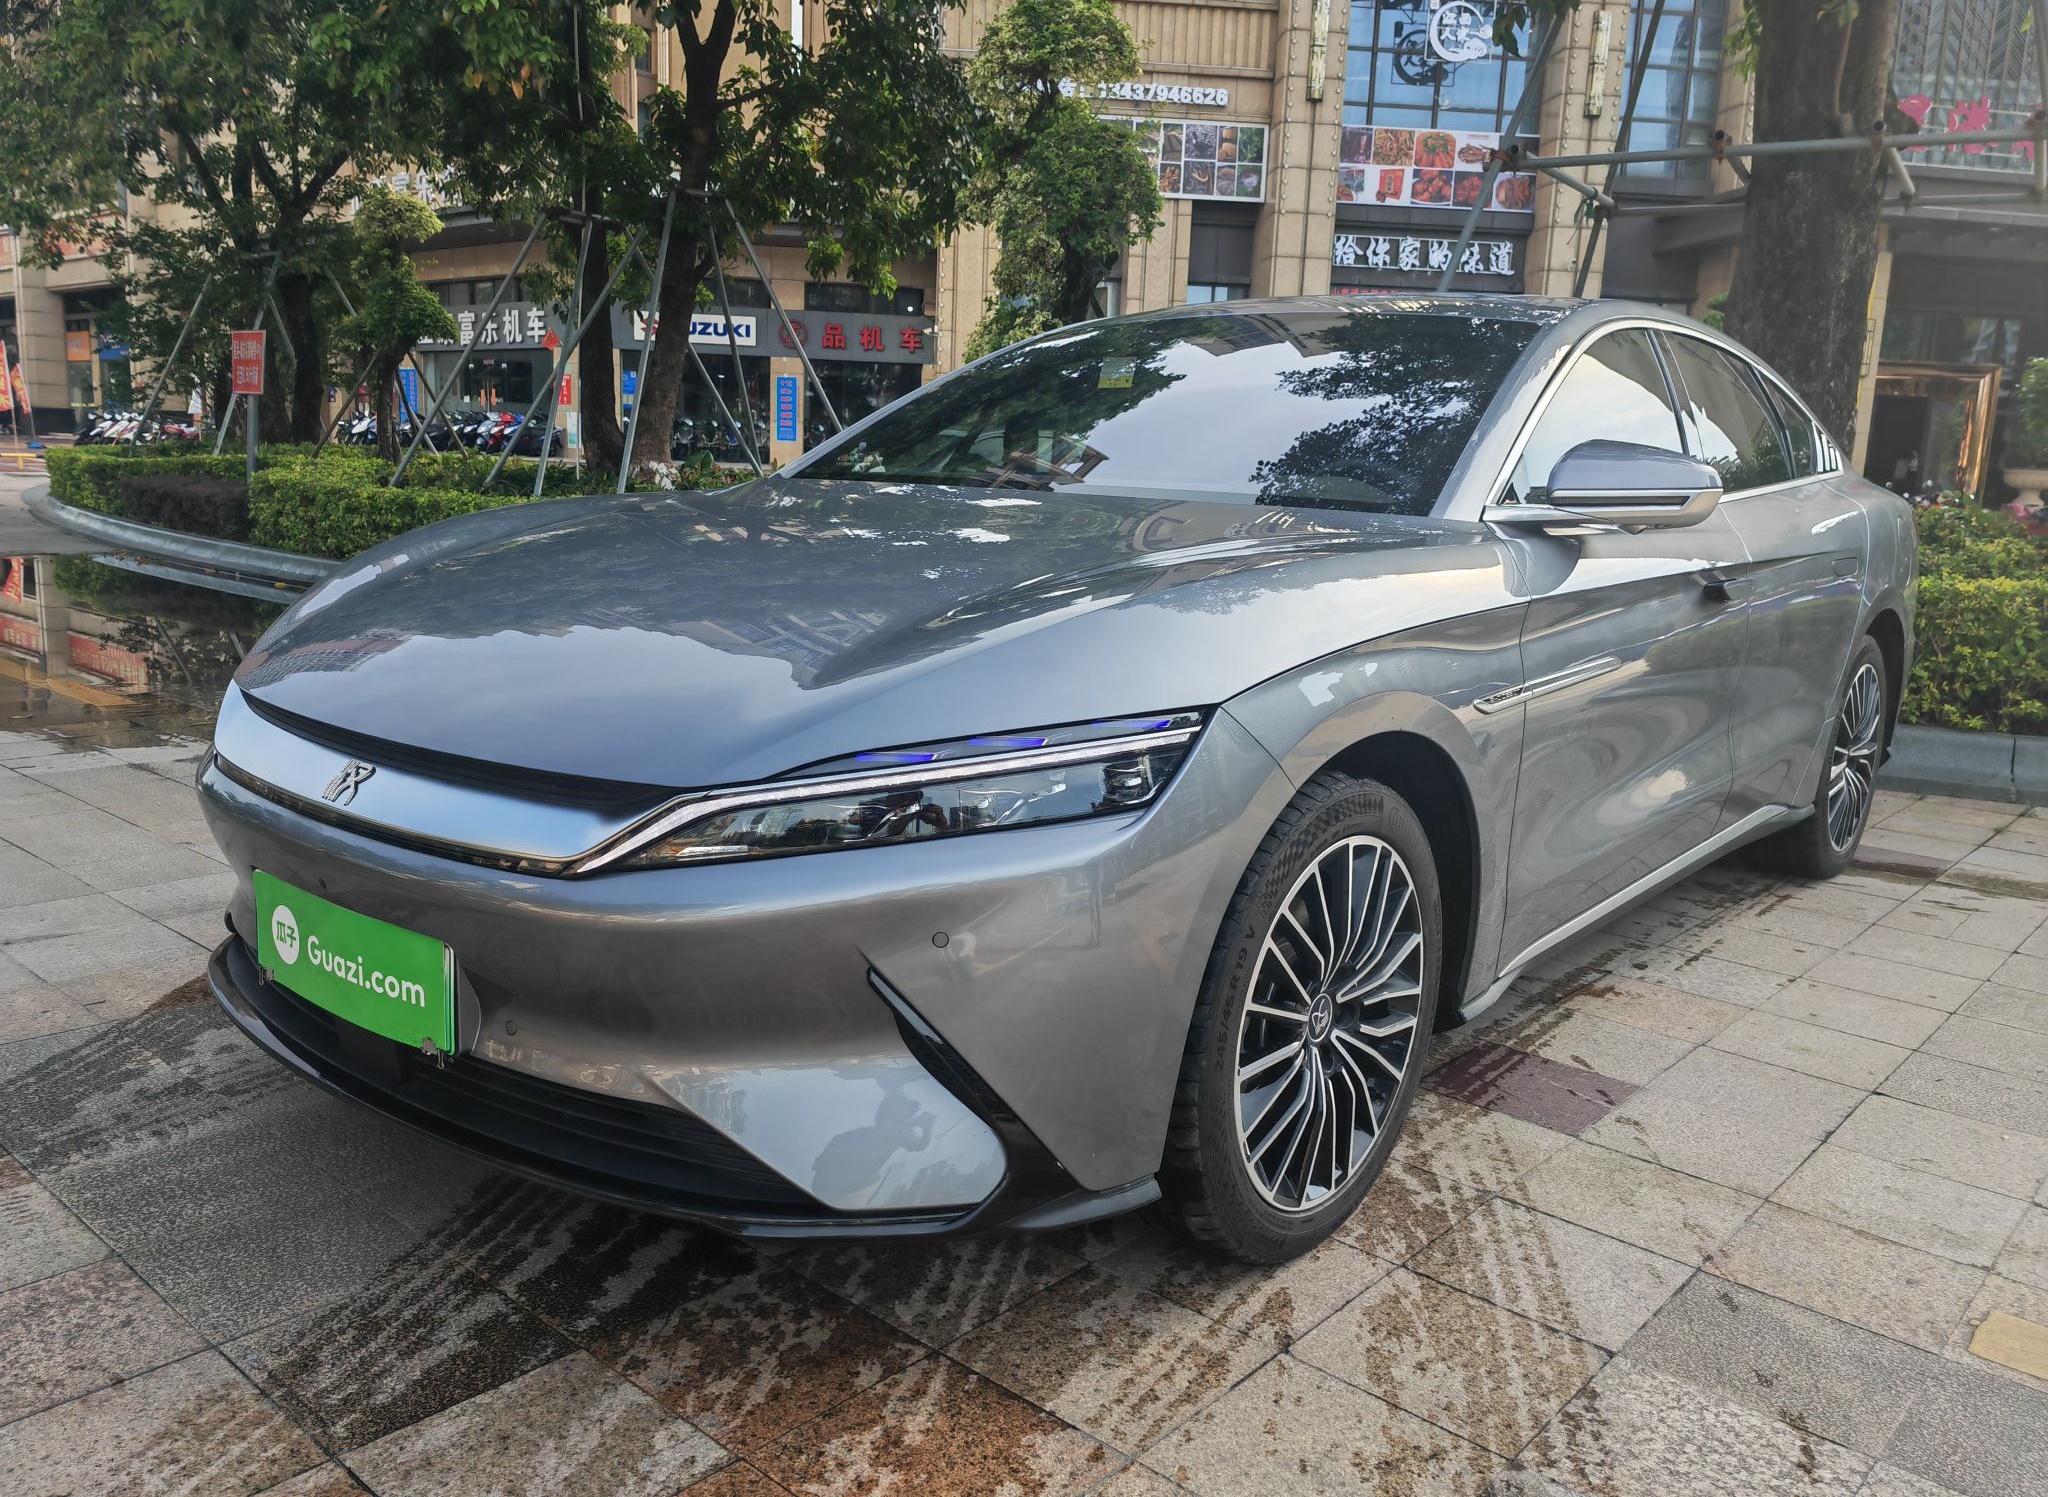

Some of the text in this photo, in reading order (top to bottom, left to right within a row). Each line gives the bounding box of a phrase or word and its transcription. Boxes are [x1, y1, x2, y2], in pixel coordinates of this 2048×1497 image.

[689, 321, 751, 338] UZUKI
[276, 920, 297, 948] 瓜子
[307, 935, 426, 1008] Guazi.com
